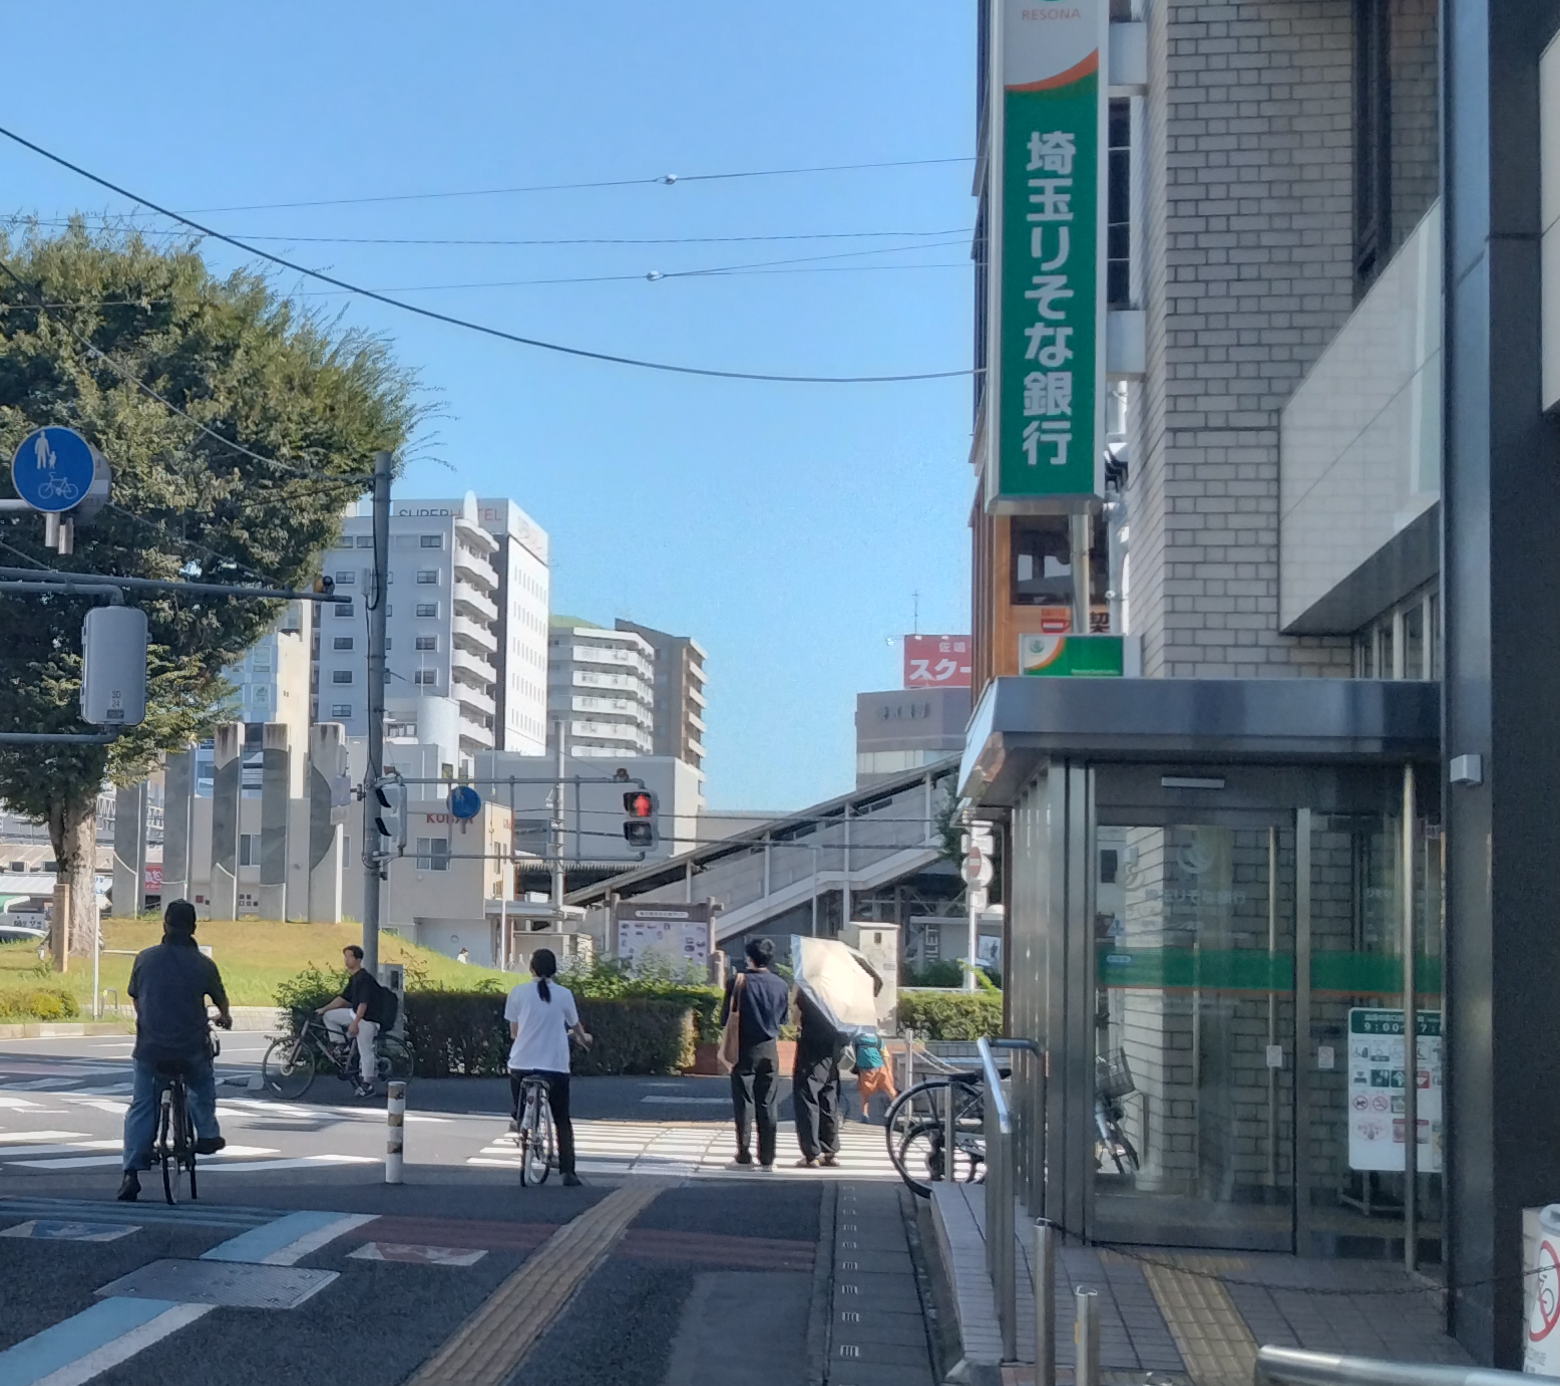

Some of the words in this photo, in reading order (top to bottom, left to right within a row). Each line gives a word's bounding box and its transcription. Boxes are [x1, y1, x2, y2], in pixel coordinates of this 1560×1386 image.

[1021, 8, 1081, 21] RESONA
[1023, 130, 1076, 468] 埼玉りそな銀行
